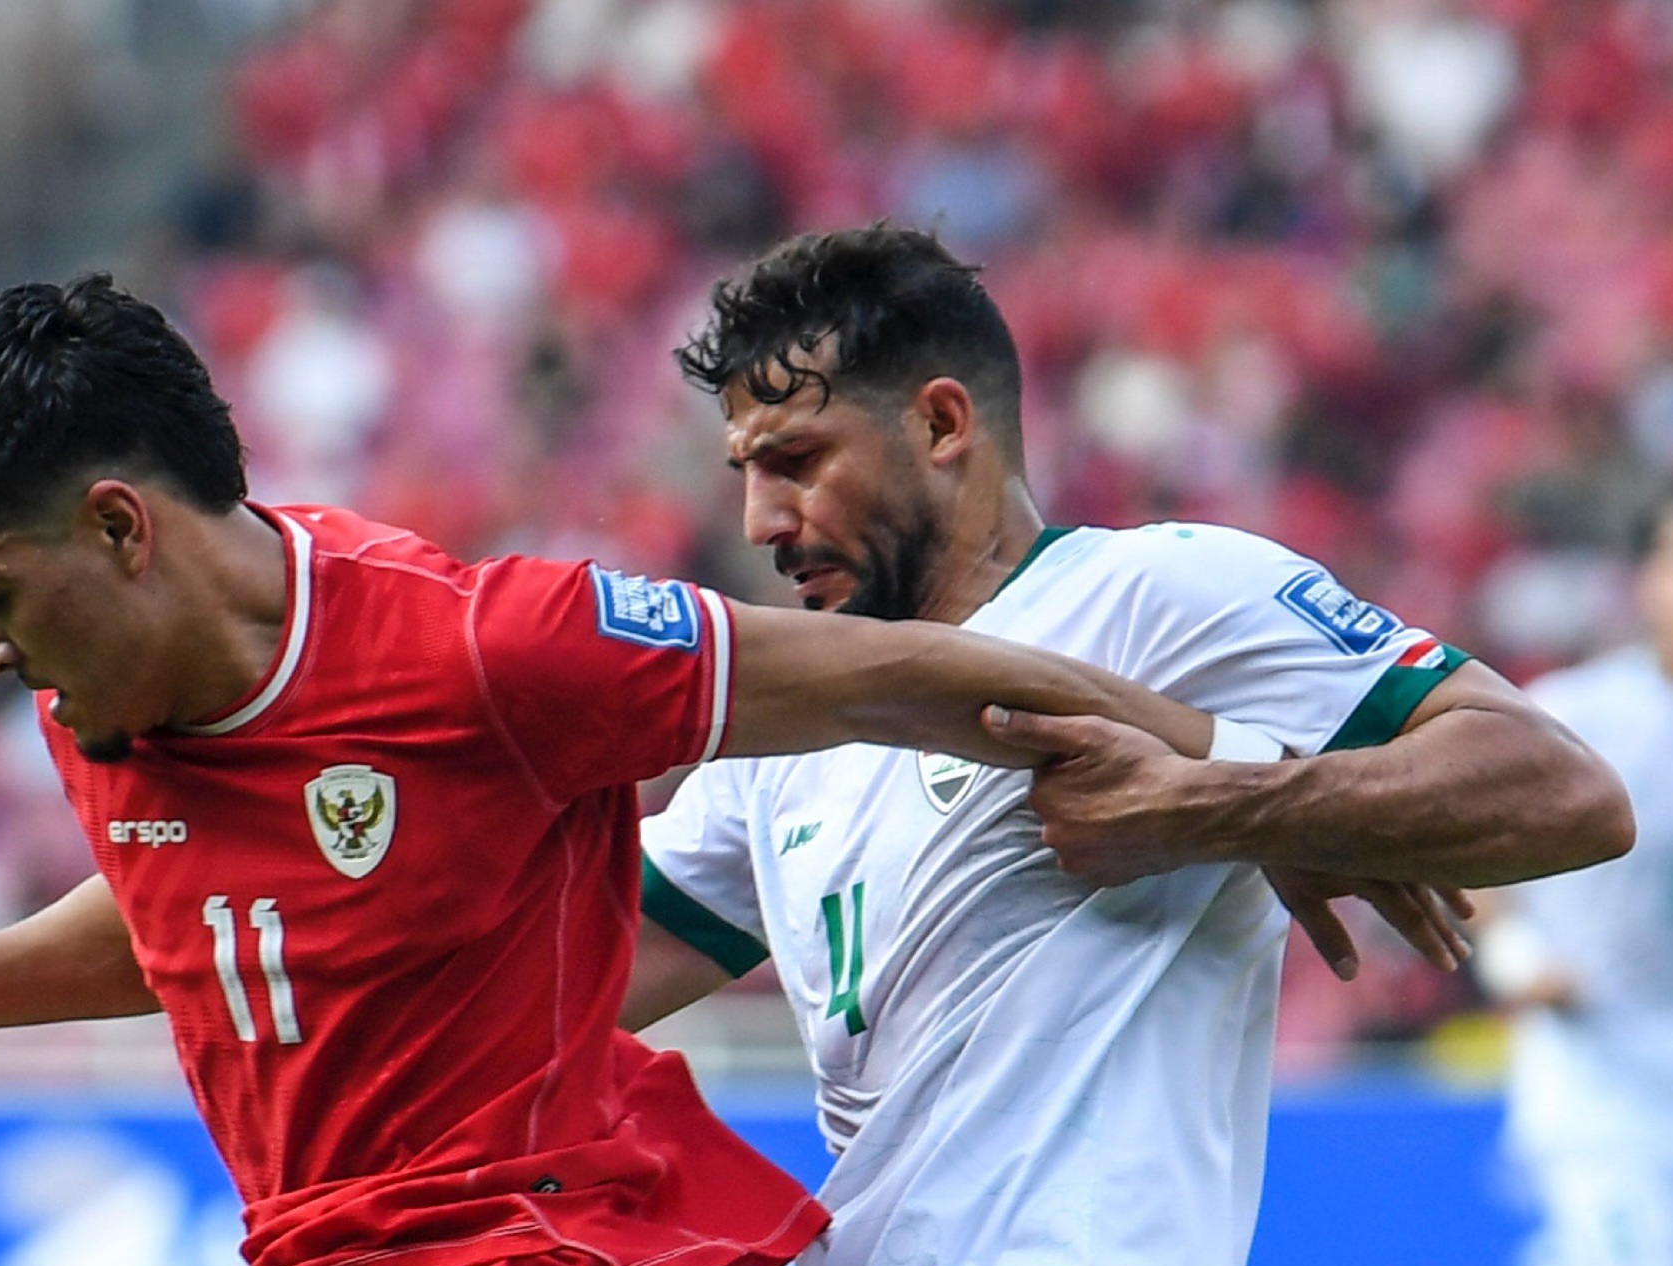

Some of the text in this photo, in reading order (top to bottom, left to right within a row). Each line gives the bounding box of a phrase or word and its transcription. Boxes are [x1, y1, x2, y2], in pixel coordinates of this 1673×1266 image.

[108, 820, 187, 848] erspo
[202, 895, 303, 1044] 11
[820, 880, 867, 1037] 4
